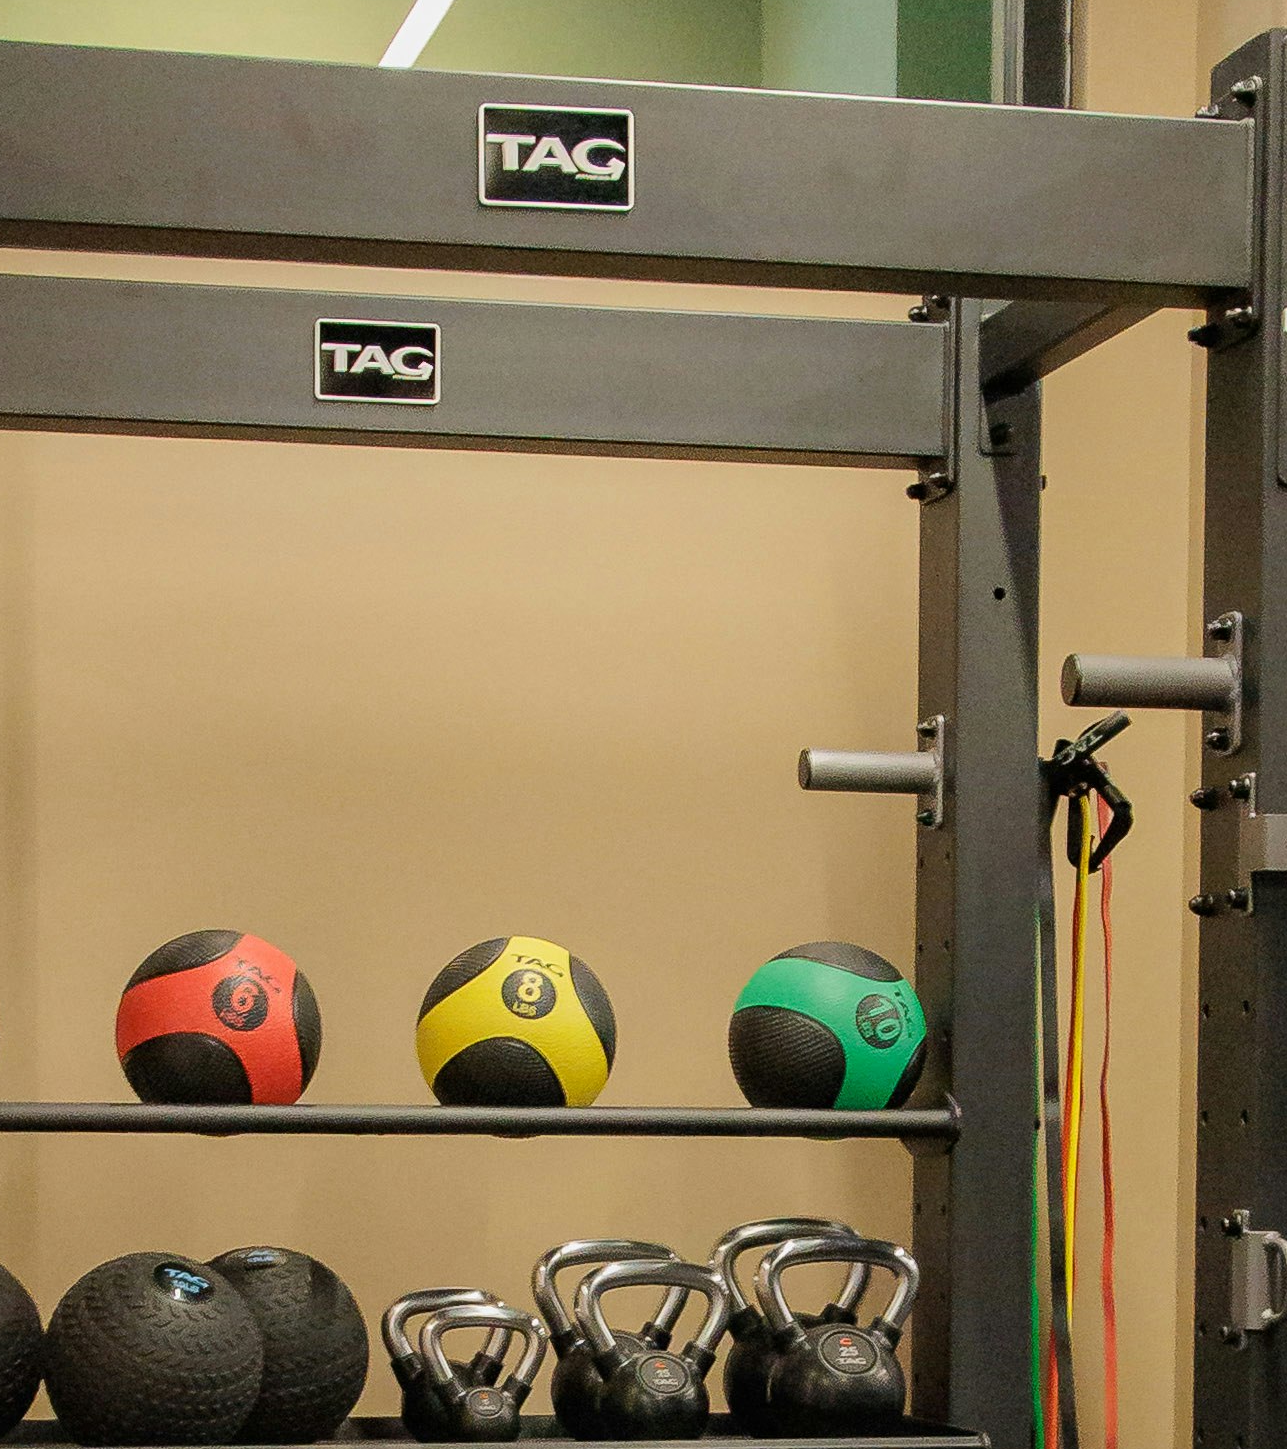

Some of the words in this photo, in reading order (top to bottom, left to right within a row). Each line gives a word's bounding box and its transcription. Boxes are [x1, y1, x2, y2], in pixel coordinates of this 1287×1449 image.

[485, 133, 626, 181] TAG
[320, 342, 434, 381] TAG
[510, 953, 565, 978] TAG
[231, 981, 260, 1013] 6
[517, 972, 543, 1002] 8
[867, 997, 902, 1040] 10
[164, 1268, 211, 1289] TAG
